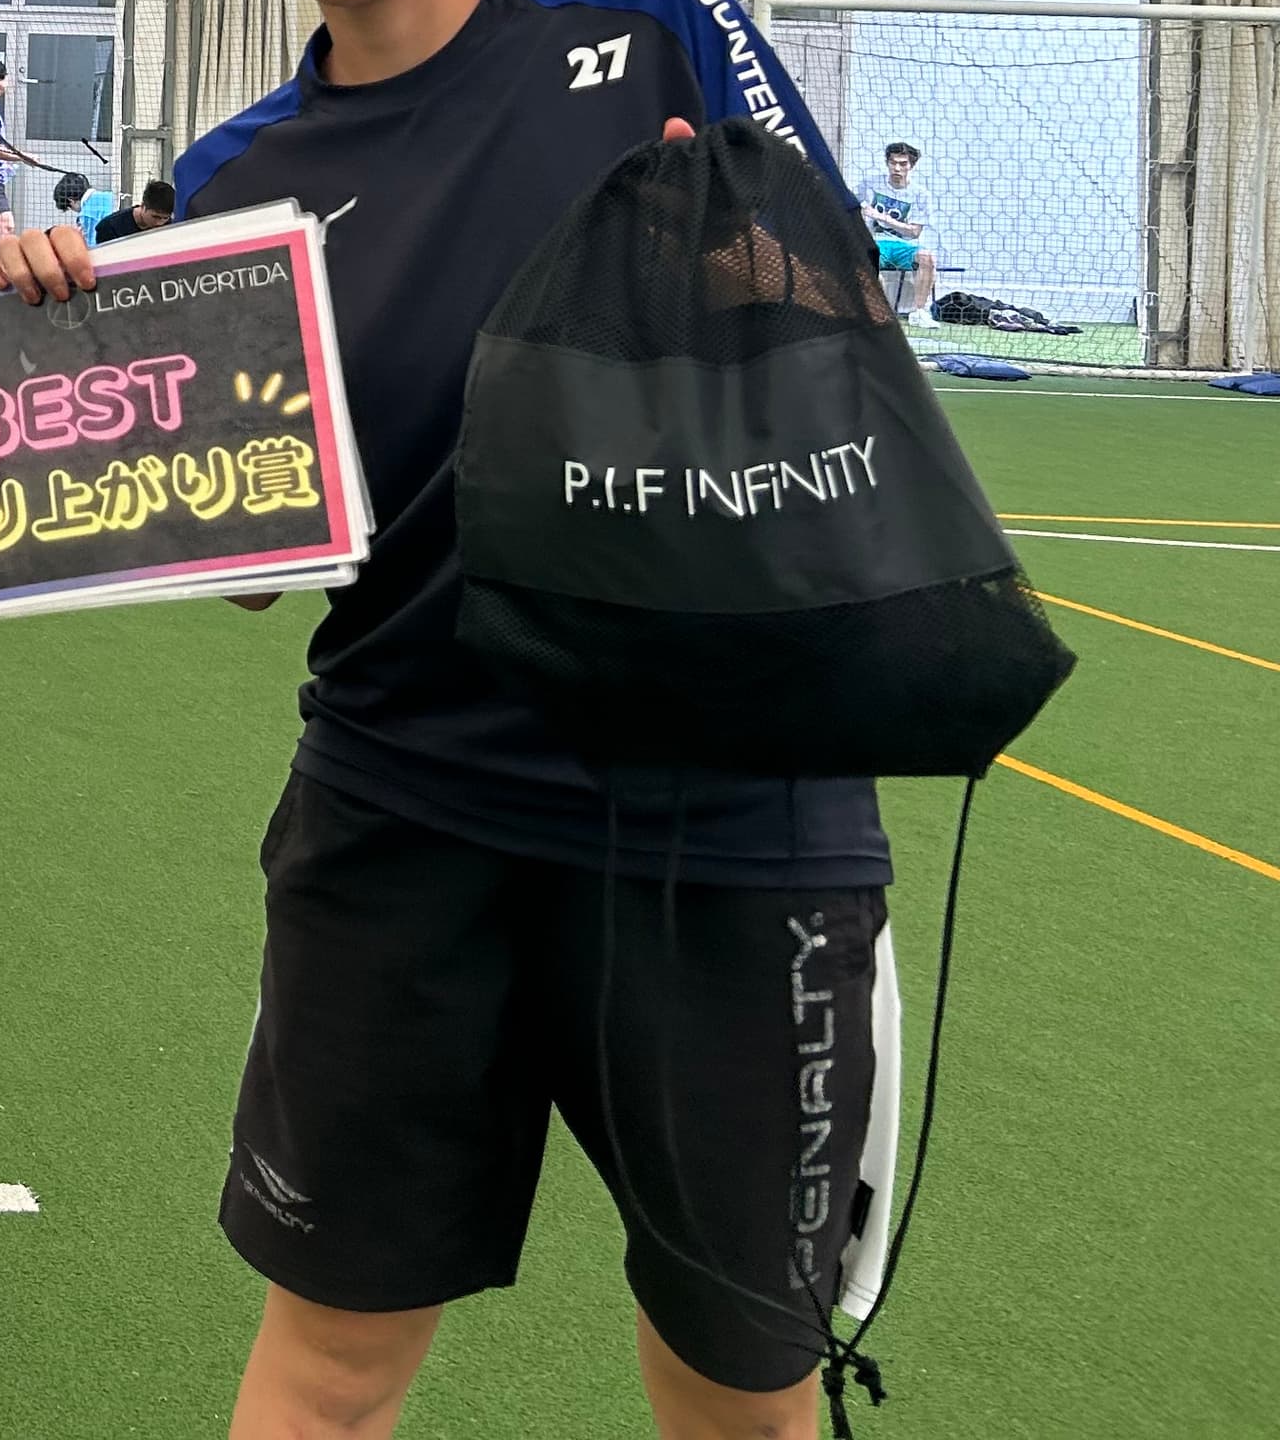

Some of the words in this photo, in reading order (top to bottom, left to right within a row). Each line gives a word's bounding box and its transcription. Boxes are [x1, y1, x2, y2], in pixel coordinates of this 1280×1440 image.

[566, 33, 632, 89] 27
[564, 460, 665, 512] P.I.F
[786, 916, 834, 1290] PENALTY
